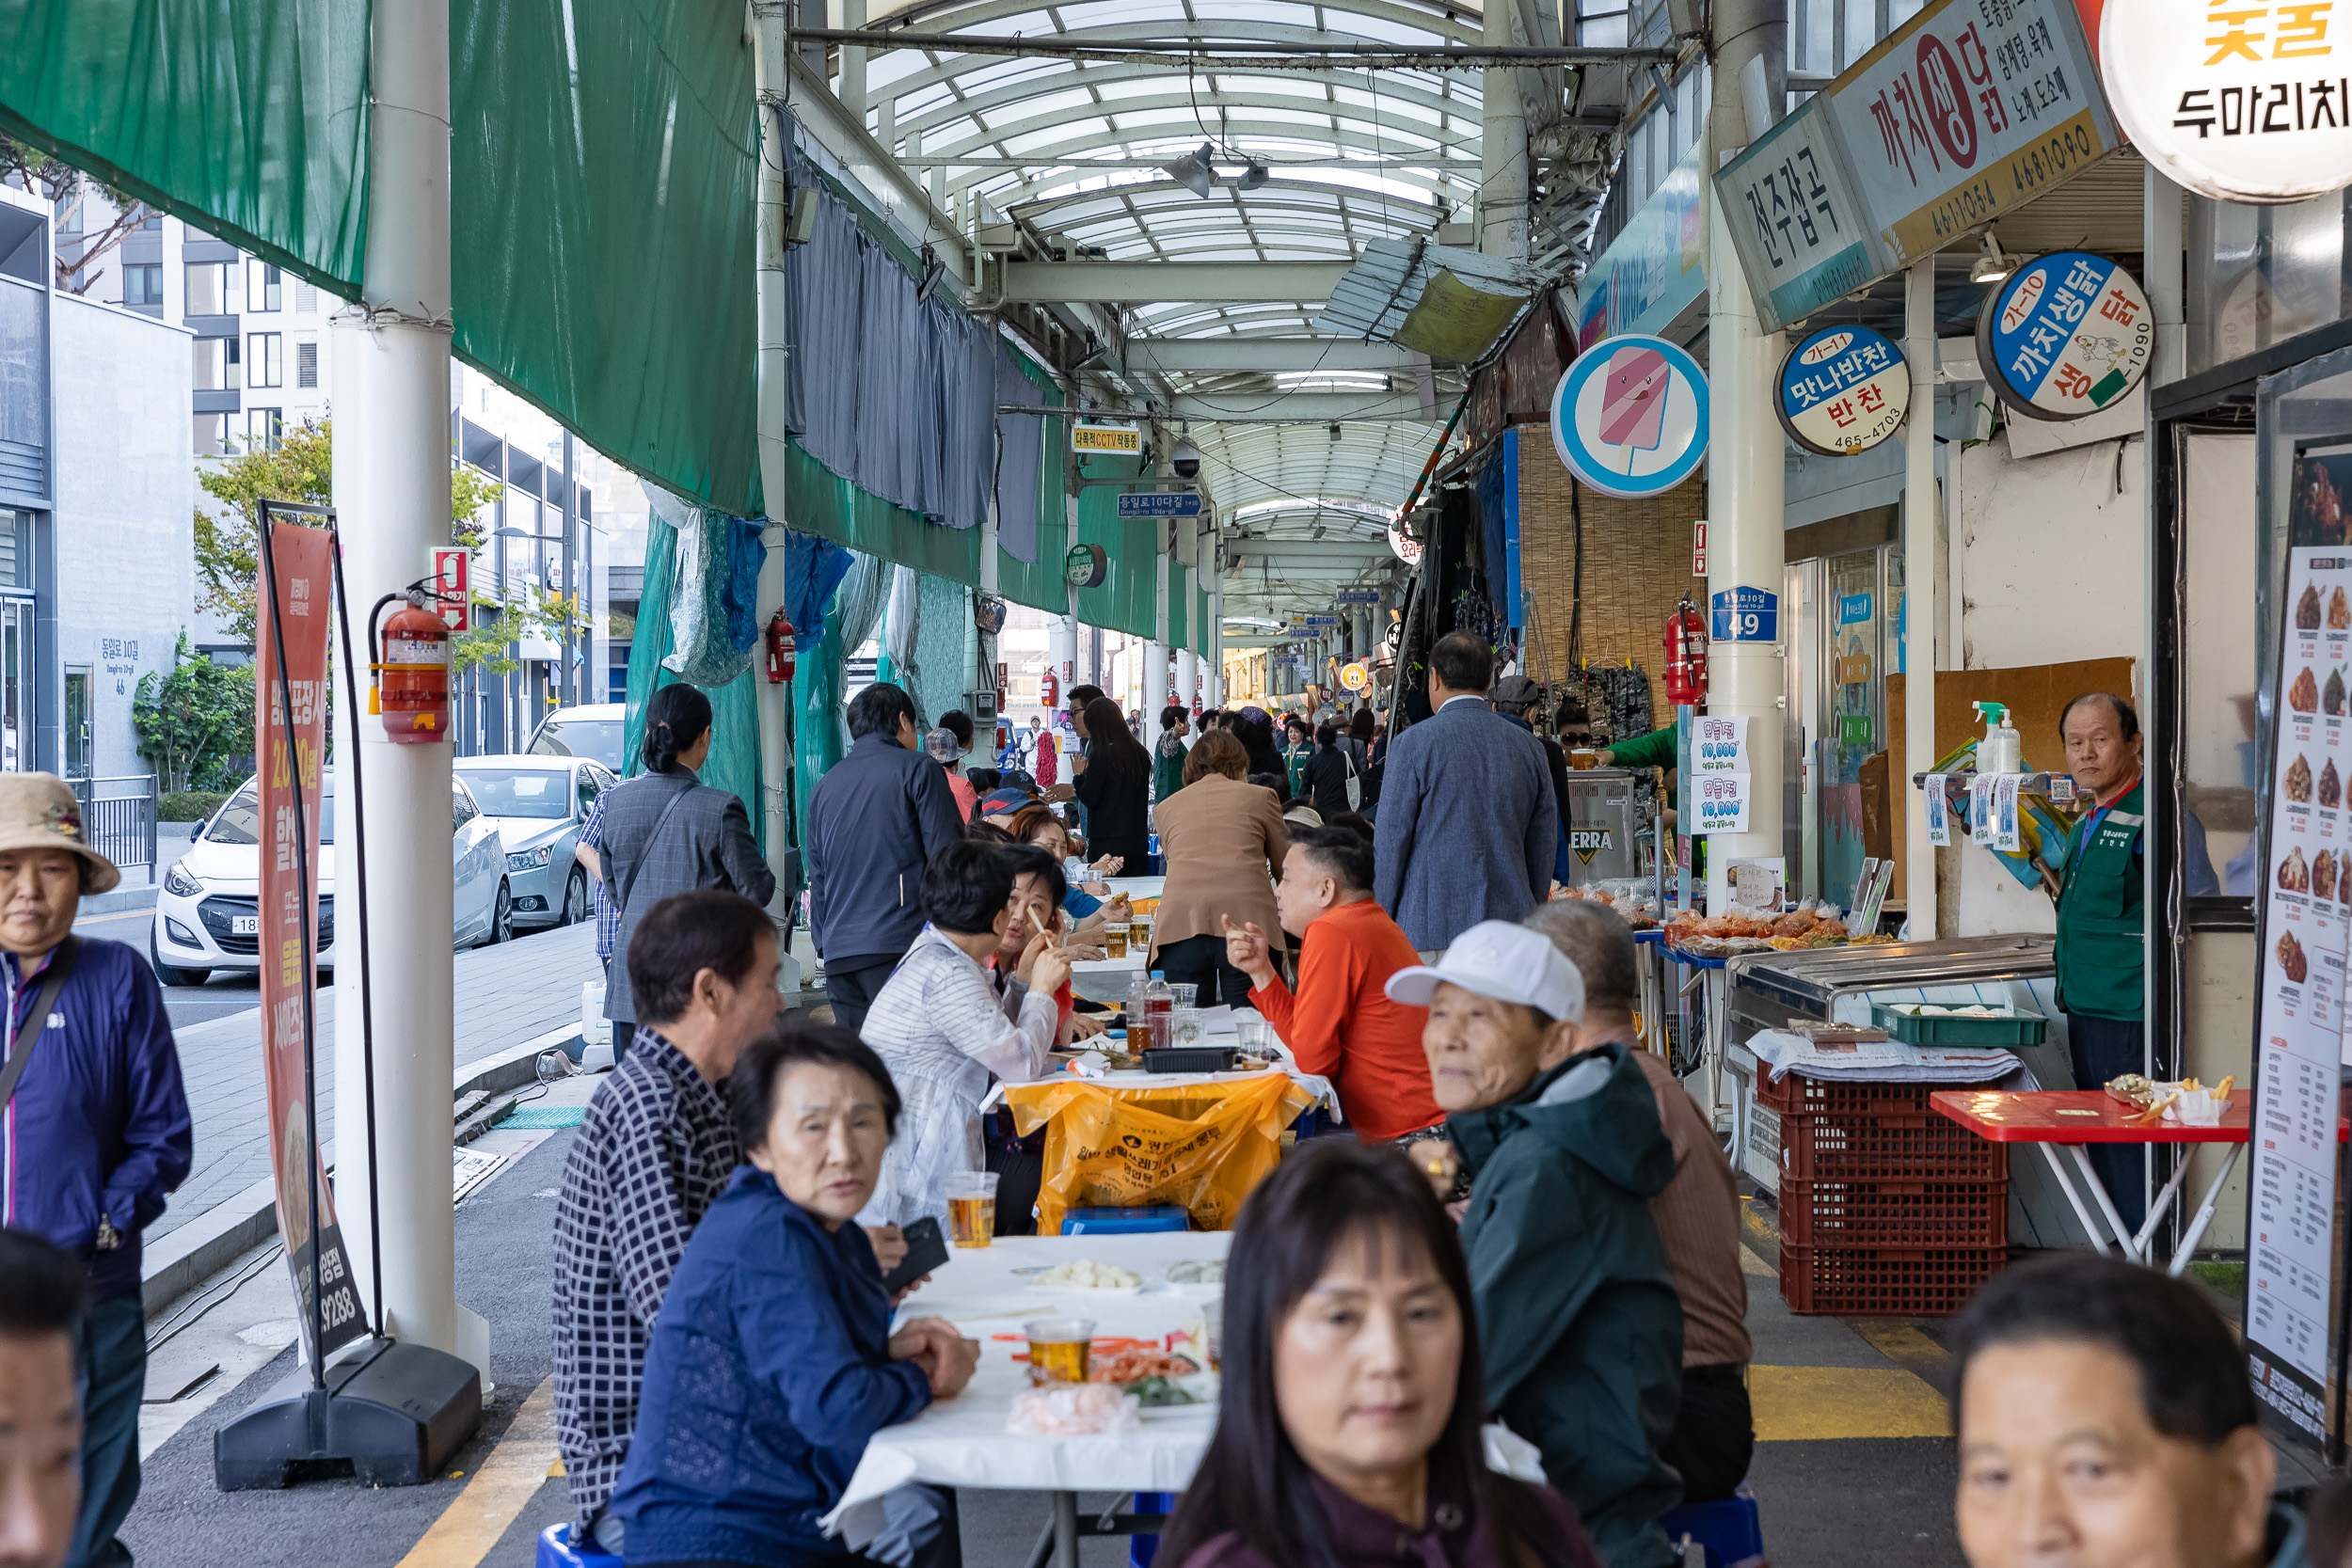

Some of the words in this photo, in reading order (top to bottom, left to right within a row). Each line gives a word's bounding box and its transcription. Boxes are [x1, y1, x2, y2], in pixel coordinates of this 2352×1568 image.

[1745, 146, 1839, 269] 전주잡곡
[2004, 275, 2043, 327] 가-10
[2010, 260, 2105, 383] 까치생닭
[1807, 333, 1849, 362] 가-11
[2053, 362, 2092, 400] 생
[2099, 289, 2141, 328] 닭
[1789, 341, 1891, 408] 맛나반찬
[1834, 407, 1901, 448] 465-4703
[1120, 496, 1183, 509] 동일로10다길
[1728, 613, 1759, 636] 49
[102, 638, 122, 659] 동일로
[123, 640, 139, 660] 10길
[1570, 832, 1613, 850] ERRA
